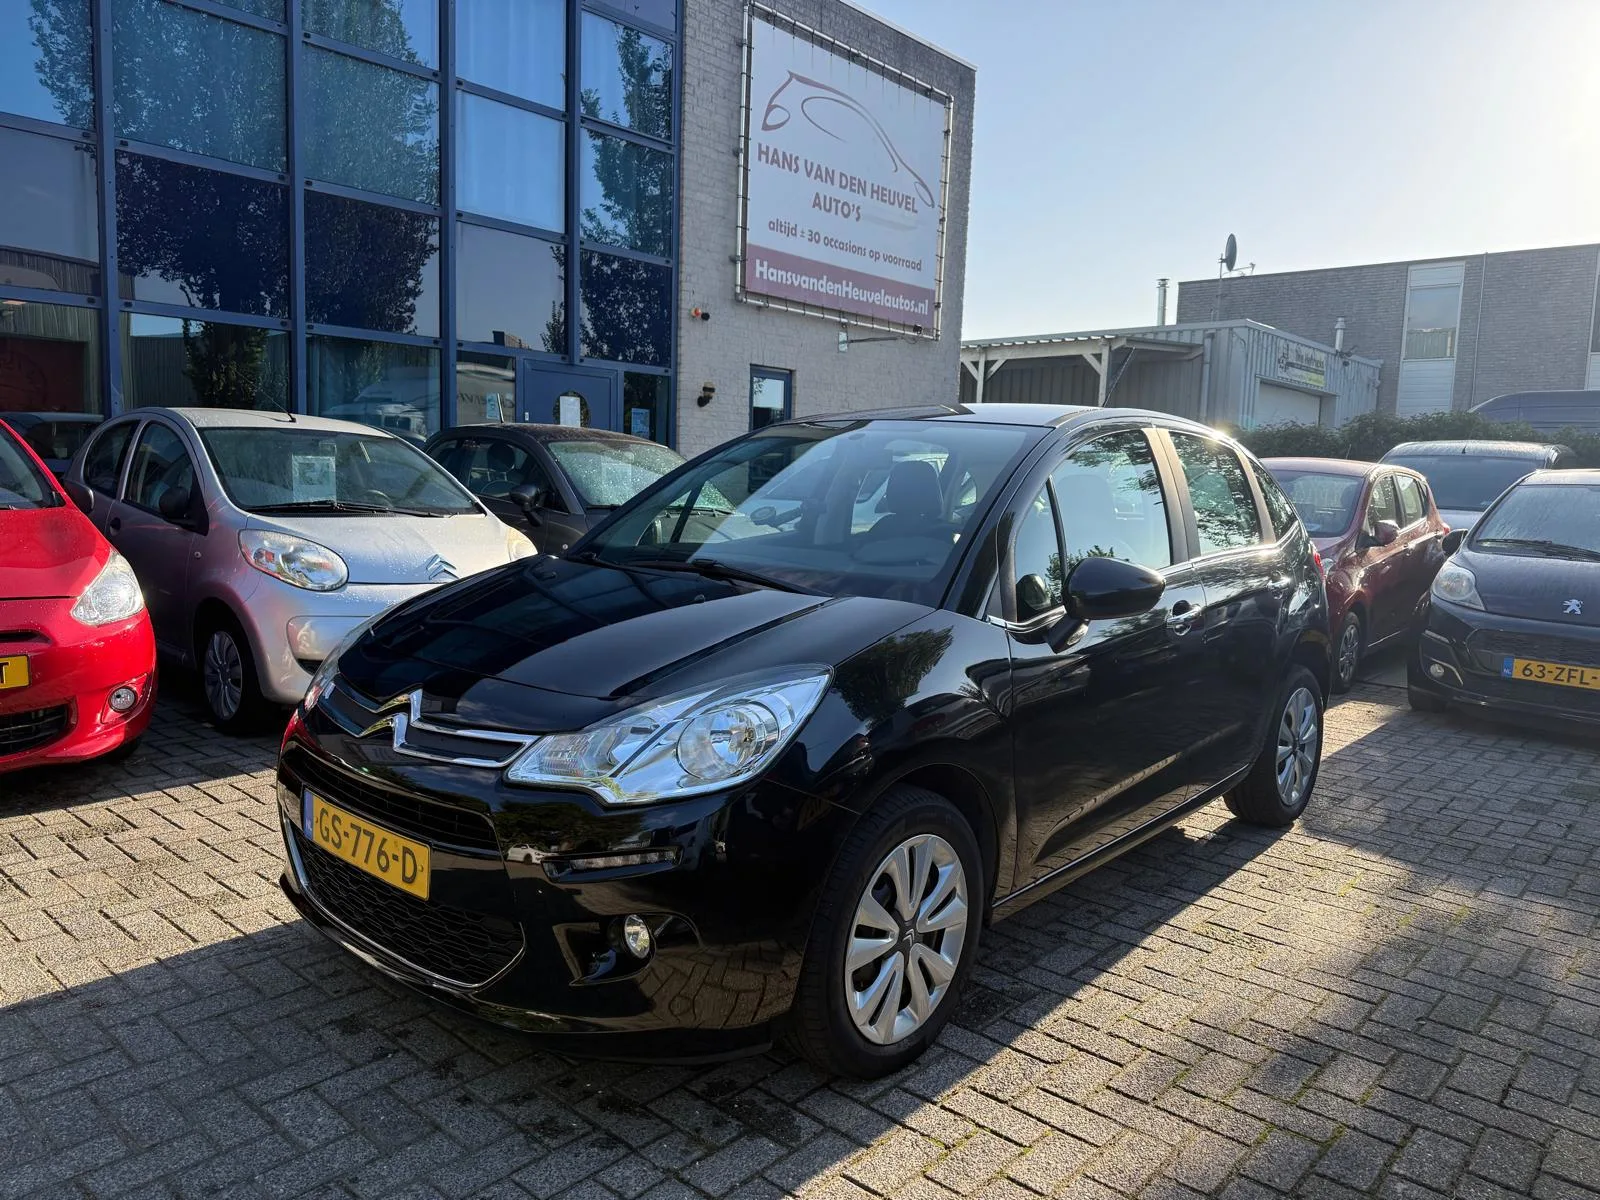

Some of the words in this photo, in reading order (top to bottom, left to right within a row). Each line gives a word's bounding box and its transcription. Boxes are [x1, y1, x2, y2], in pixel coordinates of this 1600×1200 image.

[757, 142, 800, 174] HANS
[804, 159, 836, 187] VAN
[839, 171, 867, 197] DEN
[870, 183, 918, 214] HEUVEL
[812, 191, 861, 222] AUTO'S
[768, 218, 798, 238] altijd
[807, 229, 821, 244] 30
[823, 235, 867, 257] occasions
[868, 249, 880, 263] op
[882, 252, 922, 272] voorraad
[755, 259, 929, 315] HansvandenHeuvelautos.nl
[319, 807, 418, 884] GS-776-D
